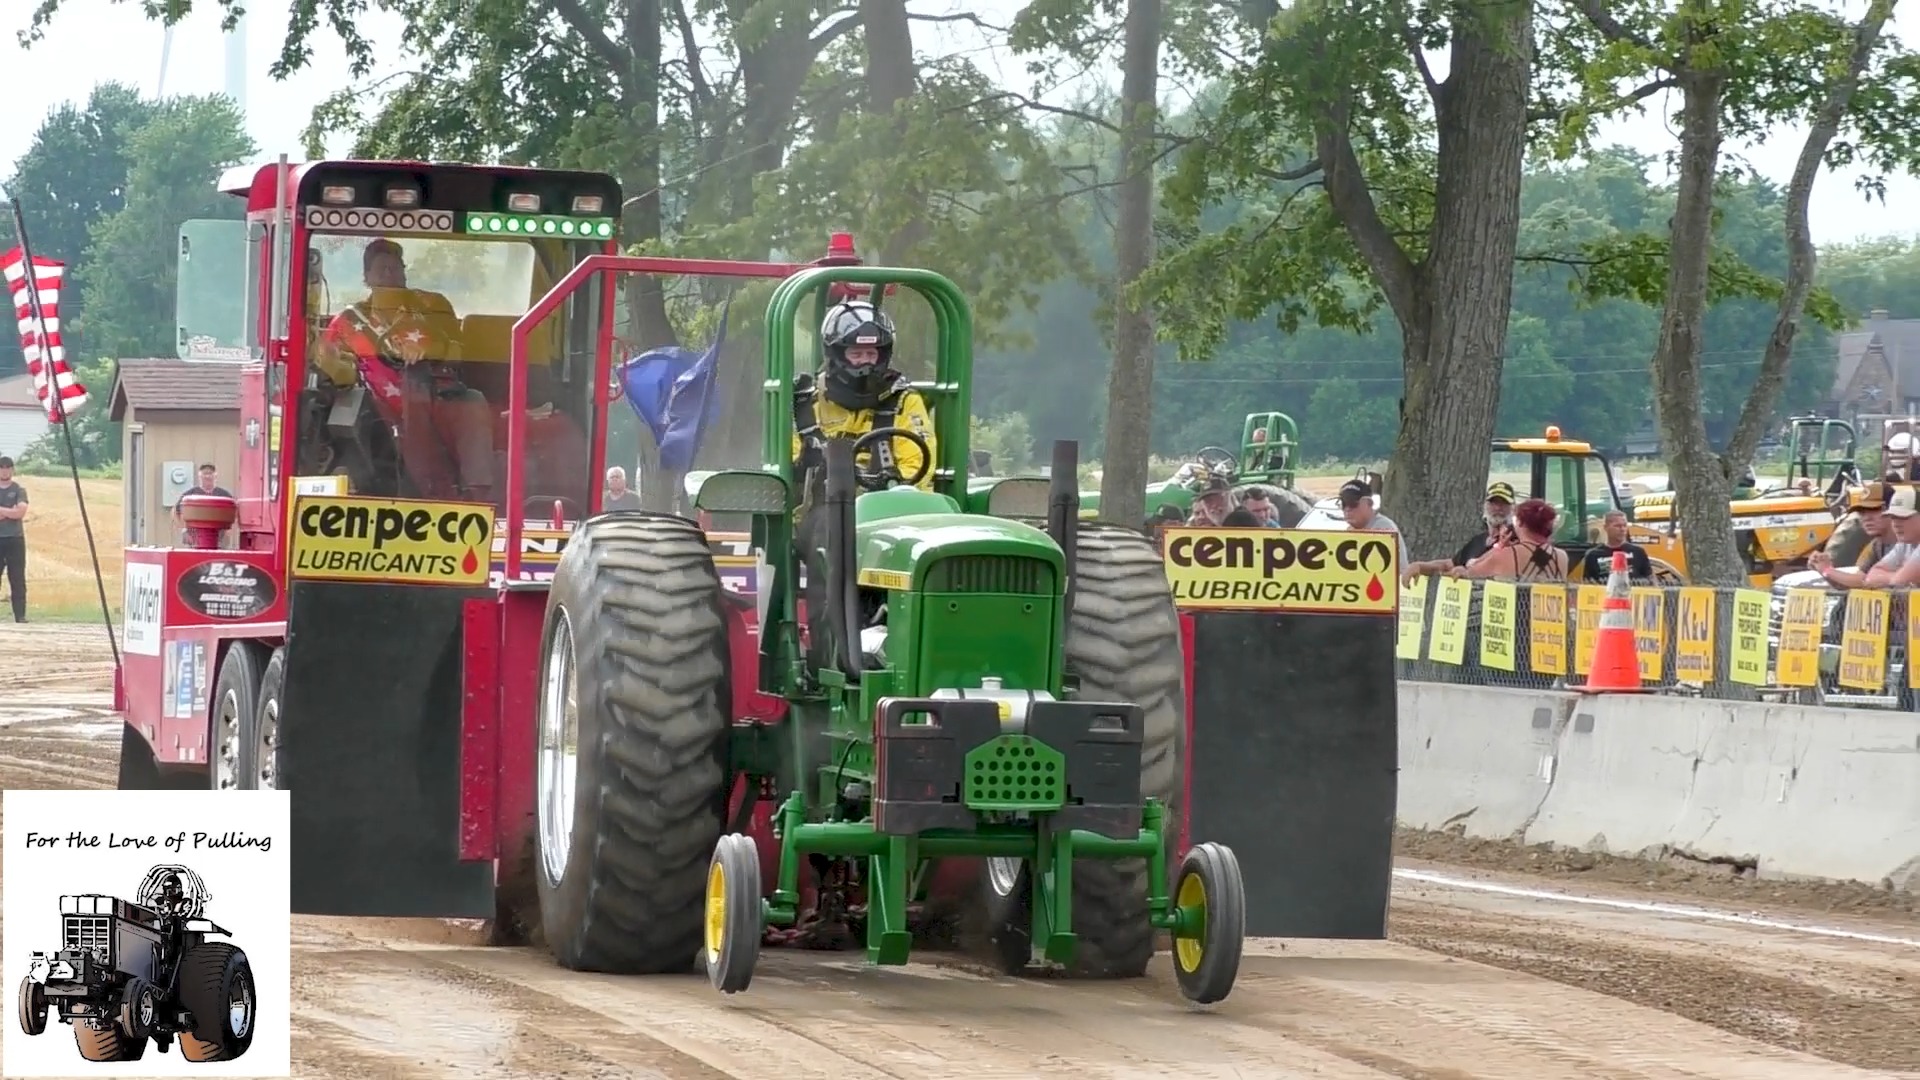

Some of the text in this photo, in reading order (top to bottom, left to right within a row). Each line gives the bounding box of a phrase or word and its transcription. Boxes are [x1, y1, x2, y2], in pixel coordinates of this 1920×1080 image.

[209, 562, 249, 577] B&T
[296, 549, 457, 575] LUBRICANTS
[198, 576, 258, 587] LOGGING
[1172, 580, 1361, 603] LUBRICANTS
[1441, 604, 1461, 620] FARMS
[1489, 610, 1506, 625] BEACH
[1484, 623, 1512, 642] COMMUNITY
[1485, 638, 1508, 657] HOSPITAL
